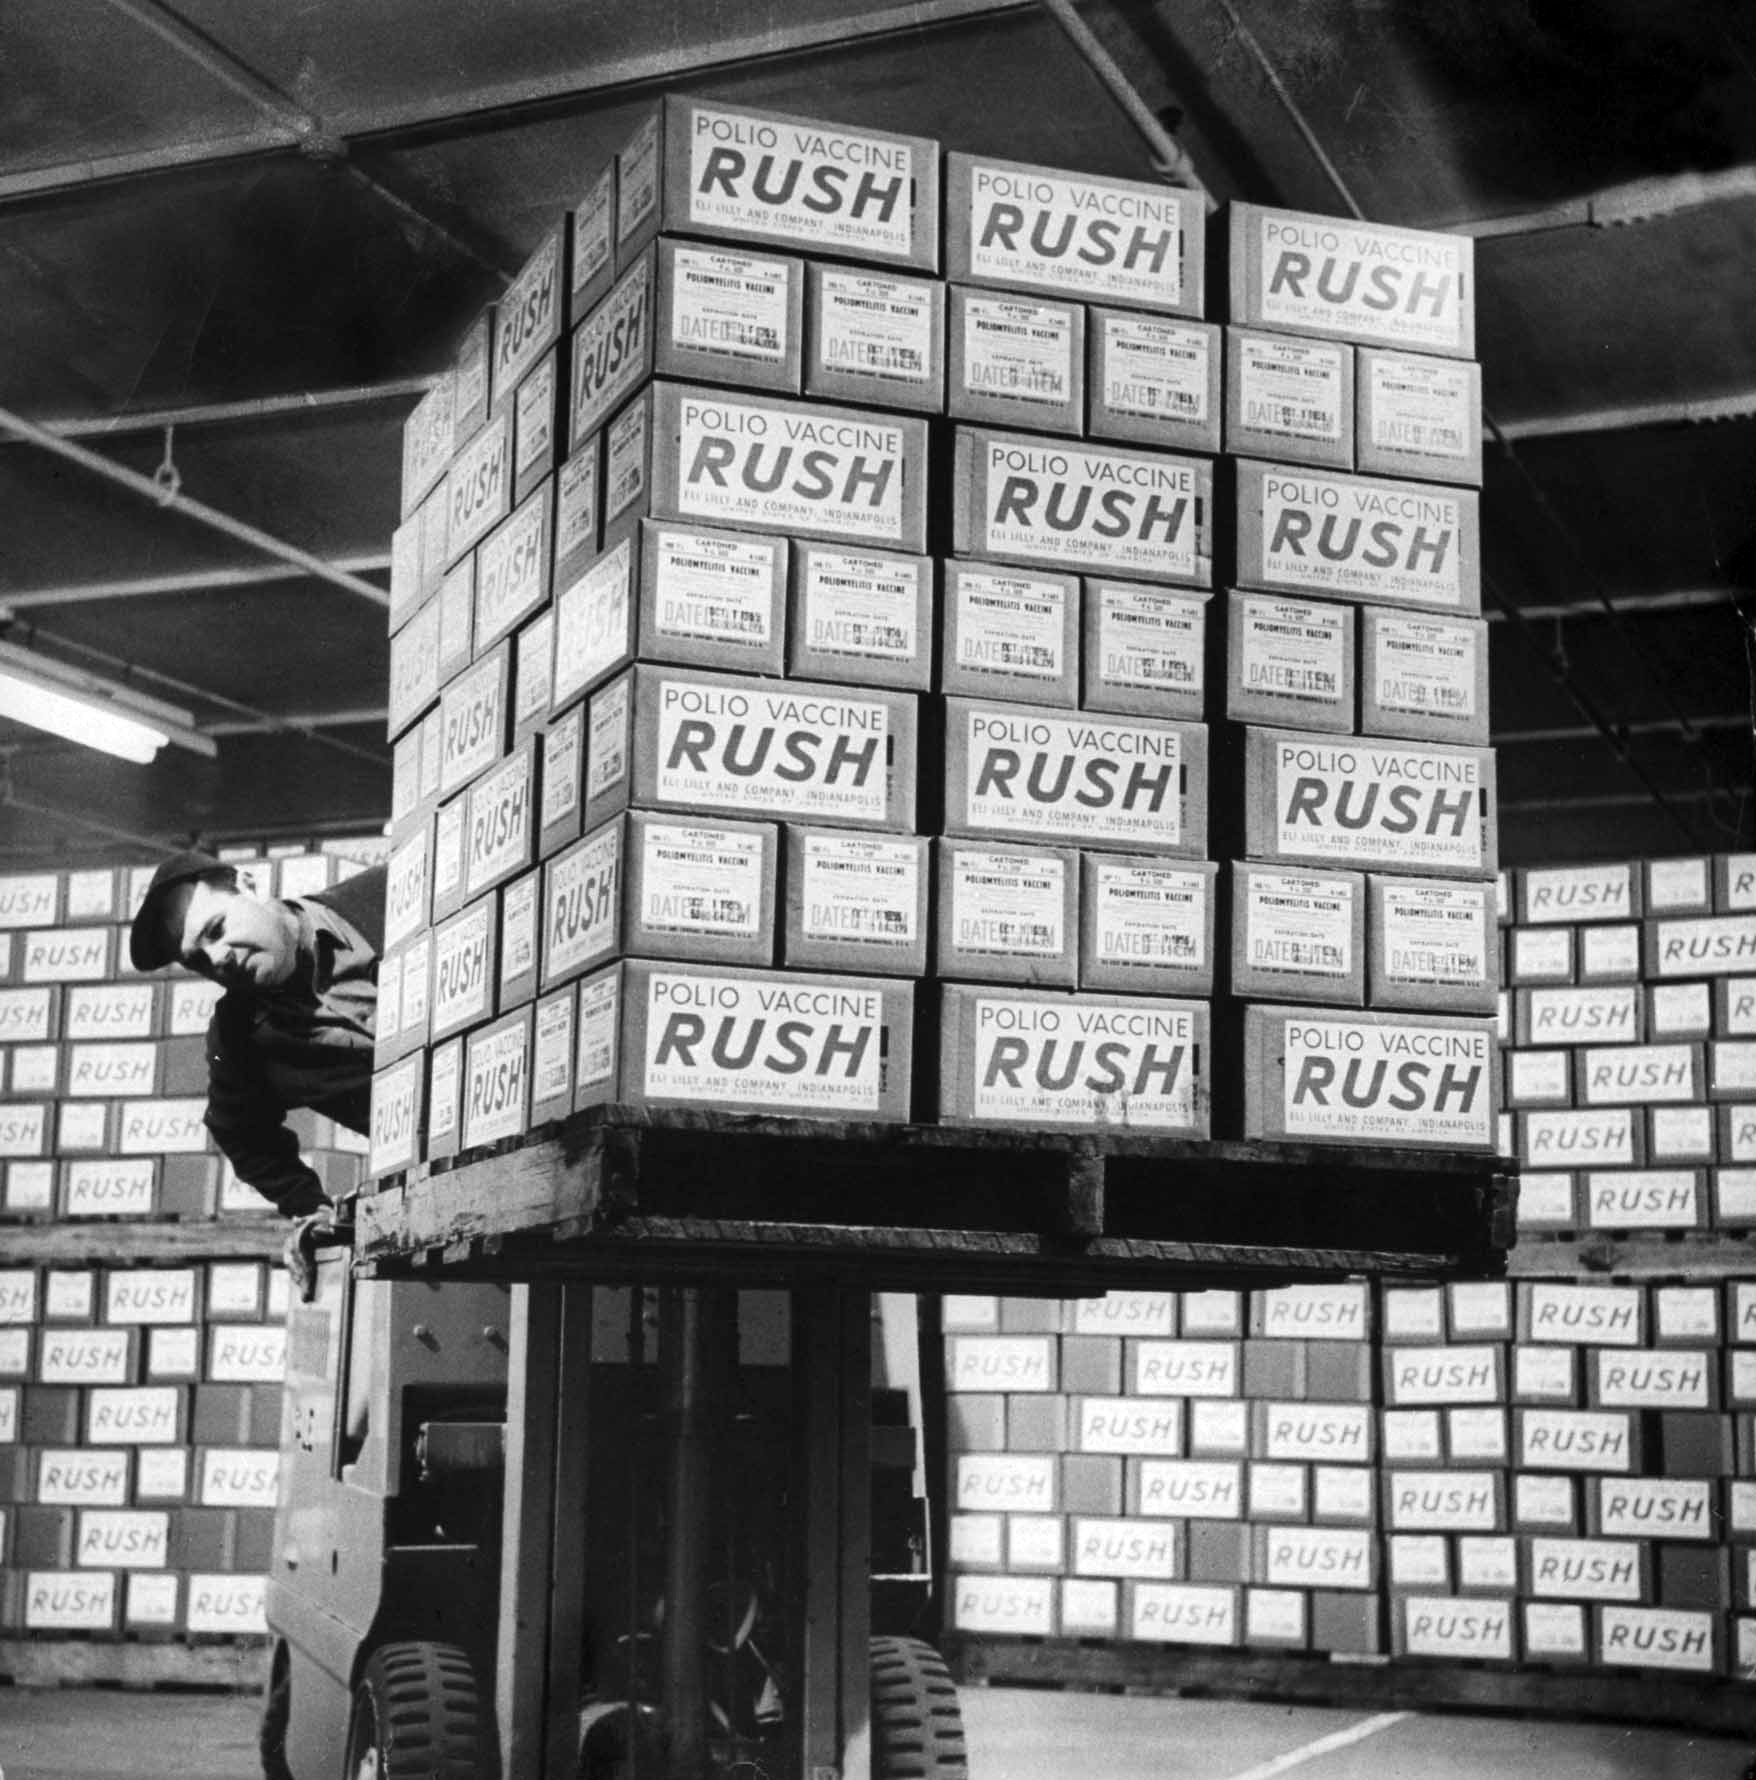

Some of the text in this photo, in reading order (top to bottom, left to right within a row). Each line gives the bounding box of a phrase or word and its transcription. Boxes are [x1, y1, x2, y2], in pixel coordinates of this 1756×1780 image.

[697, 117, 906, 171] POLIO VACCINE
[699, 147, 903, 222] RUSH
[978, 173, 1175, 225] POLIO VACCINE
[980, 202, 1171, 273] RUSH
[1268, 224, 1456, 265] POLIO VACCINE
[686, 272, 774, 295] POLIOMYELITIS VACCINE
[1270, 252, 1450, 316] RUSH
[502, 270, 549, 363] RUSH
[834, 296, 919, 317] POLIOMYELITIS VACCINE
[977, 320, 1059, 340] POLIOMYELITIS VACCINE
[582, 296, 642, 403] RUSH
[1116, 340, 1196, 359] POLIOMYELITIS VACCINE
[686, 407, 897, 453] POLIO VACCINE
[688, 436, 894, 506] RUSH
[992, 449, 1190, 492] POLIO VACCINE
[454, 449, 500, 529] RUSH
[738, 498, 757, 508] AND
[825, 509, 896, 525] INDIANAPOLIS
[995, 476, 1187, 543] RUSH
[1268, 480, 1454, 524] POLIO VACCINE
[1271, 509, 1450, 573] RUSH
[671, 557, 759, 576] POLIOMYELITIS VACCINE
[819, 576, 905, 594] POLIOMYELITIS VACCINE
[969, 596, 1052, 614] POLIOMYELITIS VACCINE
[1112, 612, 1191, 630] POLIOMYELITIS VACCINE
[1254, 622, 1332, 640] POLIOMYELITIS VACCINE
[1387, 640, 1464, 657] POLIOMYELITIS VACCINE
[666, 690, 882, 730] POLIO VACCINE
[447, 692, 495, 765] RUSH
[974, 719, 1175, 757] POLIO VACCINE
[667, 720, 879, 786] RUSH
[1283, 749, 1476, 783] POLIO VACCINE
[976, 748, 1172, 812] RUSH
[718, 783, 738, 792] AND
[808, 791, 880, 806] INDIANAPOLIS
[1286, 777, 1472, 836] RUSH
[474, 785, 526, 863] RUSH
[657, 850, 748, 867] POLIOMYELITIS VACCINE
[817, 861, 904, 875] POLIOMYELITIS VACCINE
[966, 875, 1051, 889] POLIOMYELITIS VACCINE
[0, 890, 51, 914] USH
[555, 863, 615, 947] RUSH
[1109, 888, 1193, 902] POLIOMYELITIS VACCINE
[1260, 896, 1340, 911] POLIOMYELITIS VACCINE
[1533, 883, 1624, 907] RUSH
[1395, 907, 1473, 921] POLIOMYELITIS VACCINE
[29, 943, 102, 966] RUSH
[1665, 936, 1756, 959] RUSH
[441, 942, 486, 1001] RUSH
[74, 1001, 147, 1023] RUSH
[655, 982, 875, 1018] POLIO VACCINE
[981, 1007, 1187, 1038] POLIO VACCINE
[1537, 1005, 1629, 1027] RUSH
[655, 1012, 872, 1077] RUSH
[1290, 1028, 1484, 1058] POLIO VACCINE
[76, 1060, 150, 1082] RUSH
[984, 1037, 1184, 1095] RUSH
[1593, 1064, 1686, 1086] RUSH
[473, 1055, 525, 1120] RUSH
[707, 1077, 728, 1087] AND
[799, 1083, 873, 1096] INDIANAPOLIS
[1293, 1056, 1482, 1113] RUSH
[127, 1116, 201, 1137] RUSH
[376, 1091, 413, 1145] RUSH
[1338, 1115, 1357, 1124] AND
[1419, 1119, 1485, 1131] INDIANAPOLIS
[0, 1123, 38, 1143] SH
[1535, 1127, 1626, 1150] RUSH
[74, 1179, 149, 1200] RUSH
[1597, 1189, 1689, 1211] RUSH
[113, 1286, 189, 1308] RUSH
[1083, 1297, 1165, 1320] RUSH
[1271, 1300, 1358, 1323] RUSH
[1538, 1303, 1632, 1328] RUSH
[48, 1347, 123, 1369] RUSH
[962, 1353, 1042, 1377] RUSH
[1143, 1358, 1228, 1381] RUSH
[1401, 1365, 1489, 1386] RUSH
[1606, 1368, 1700, 1391] RUSH
[95, 1405, 171, 1428] RUSH
[1087, 1417, 1171, 1439] RUSH
[1274, 1422, 1360, 1445] RUSH
[1530, 1429, 1623, 1453] RUSH
[45, 1467, 121, 1490] RUSH
[963, 1472, 1045, 1495] RUSH
[1147, 1479, 1233, 1502] RUSH
[1399, 1490, 1487, 1513] RUSH
[1607, 1497, 1703, 1522] RUSH
[85, 1528, 161, 1552] RUSH
[1083, 1537, 1168, 1561] RUSH
[1274, 1546, 1362, 1570] RUSH
[1539, 1558, 1632, 1582] RUSH
[32, 1588, 108, 1611] RUSH
[961, 1594, 1043, 1618] RUSH
[1138, 1599, 1225, 1624] RUSH
[1413, 1616, 1503, 1640] RUSH
[1609, 1627, 1706, 1653] RUSH
